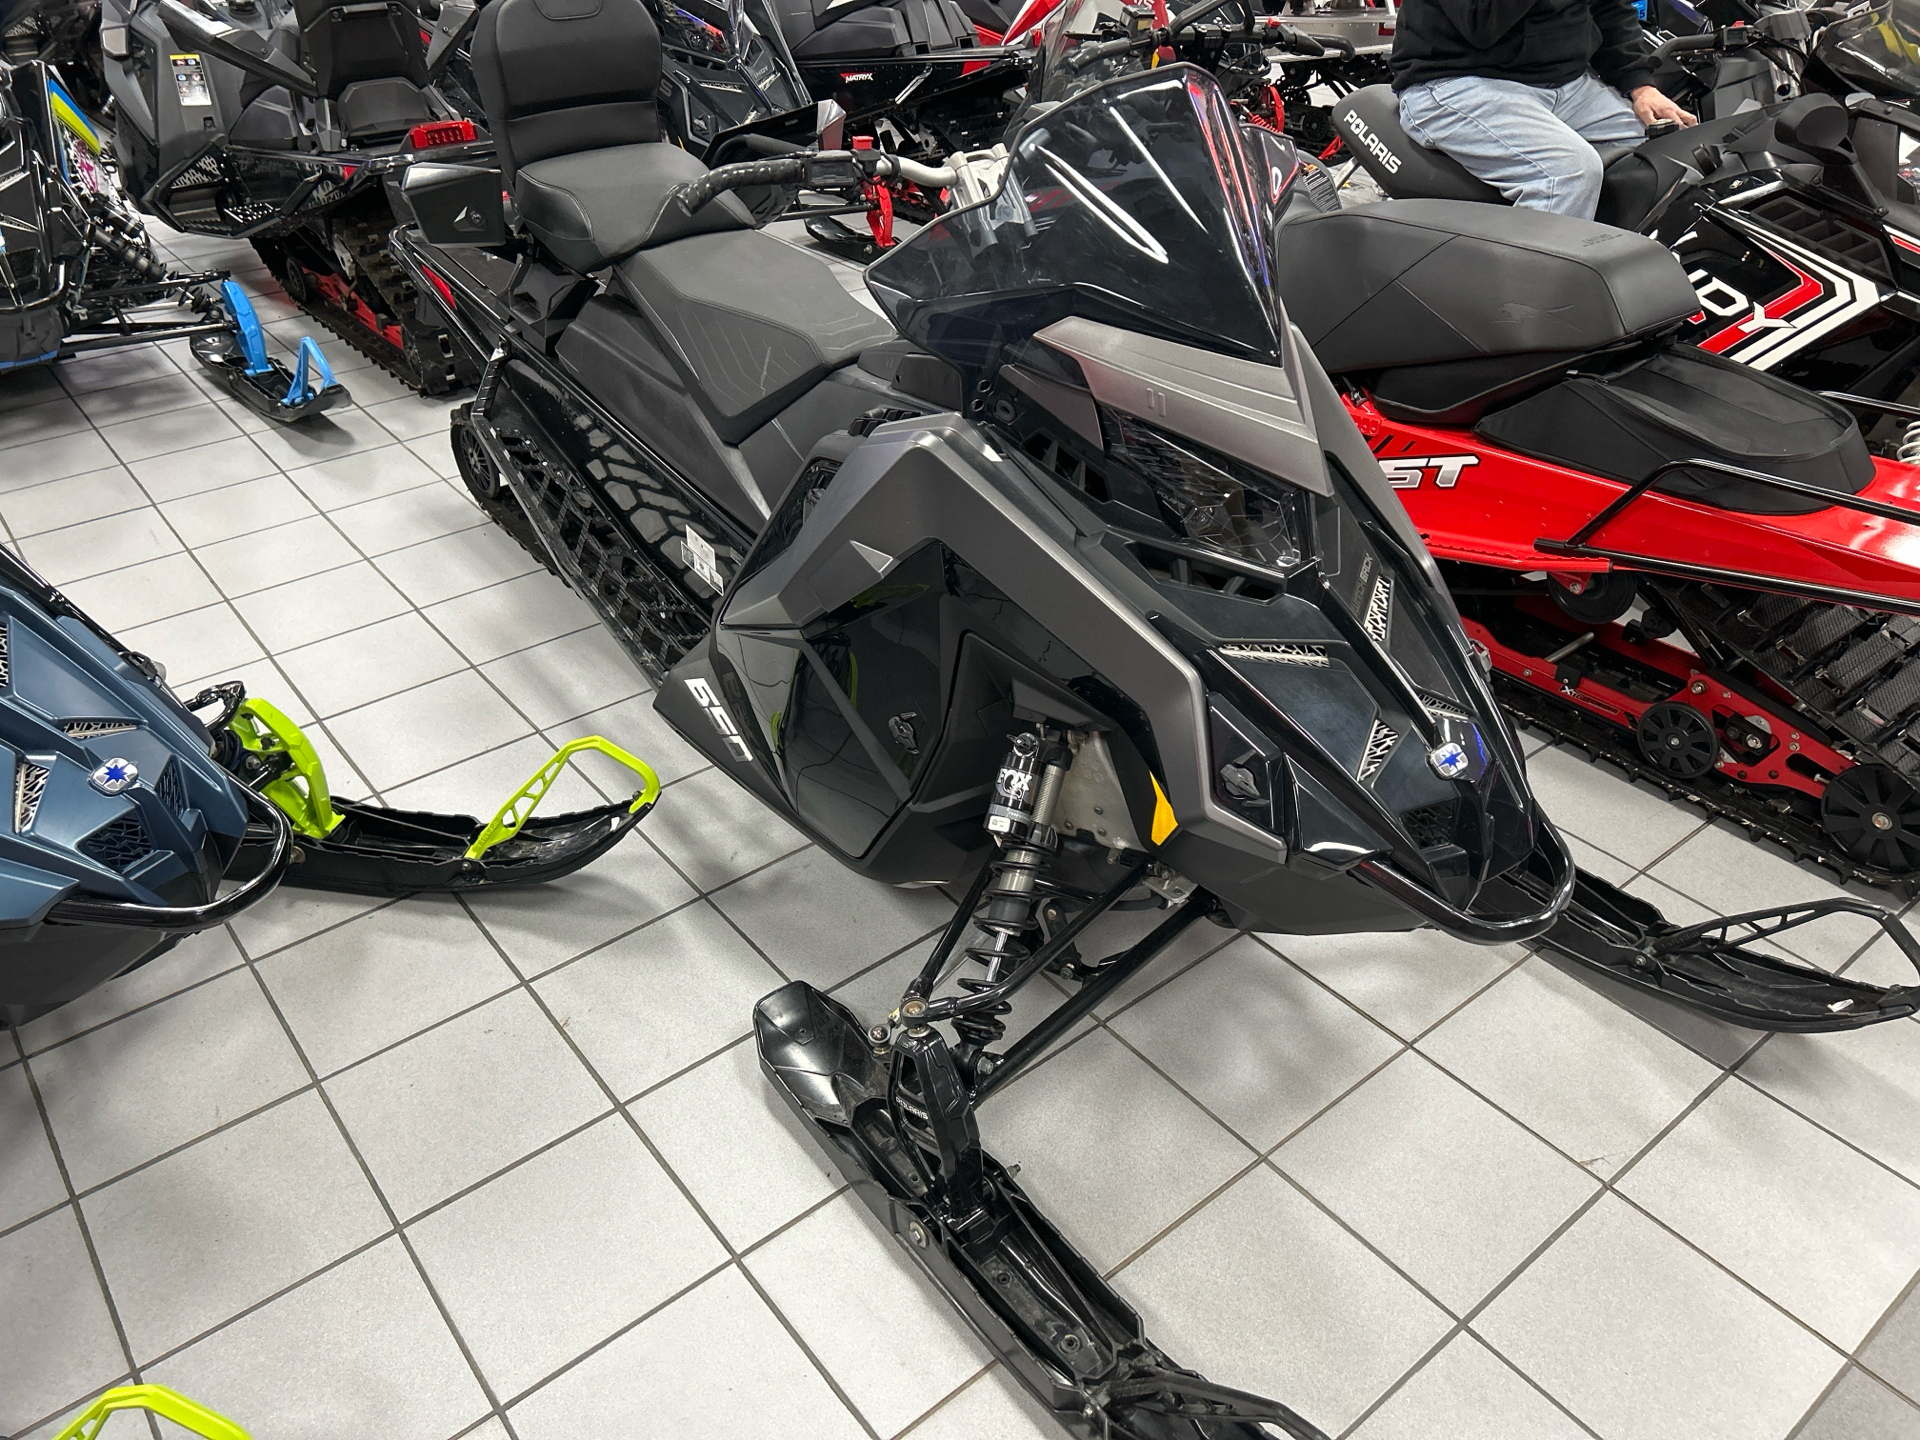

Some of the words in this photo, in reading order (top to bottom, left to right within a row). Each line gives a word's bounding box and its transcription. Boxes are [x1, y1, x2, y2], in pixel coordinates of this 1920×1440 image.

[845, 72, 874, 84] MATRYX
[1343, 109, 1402, 174] POLARIS
[683, 677, 754, 763] 650
[996, 767, 1033, 799] FOX
[895, 1096, 929, 1120] POLARIS
